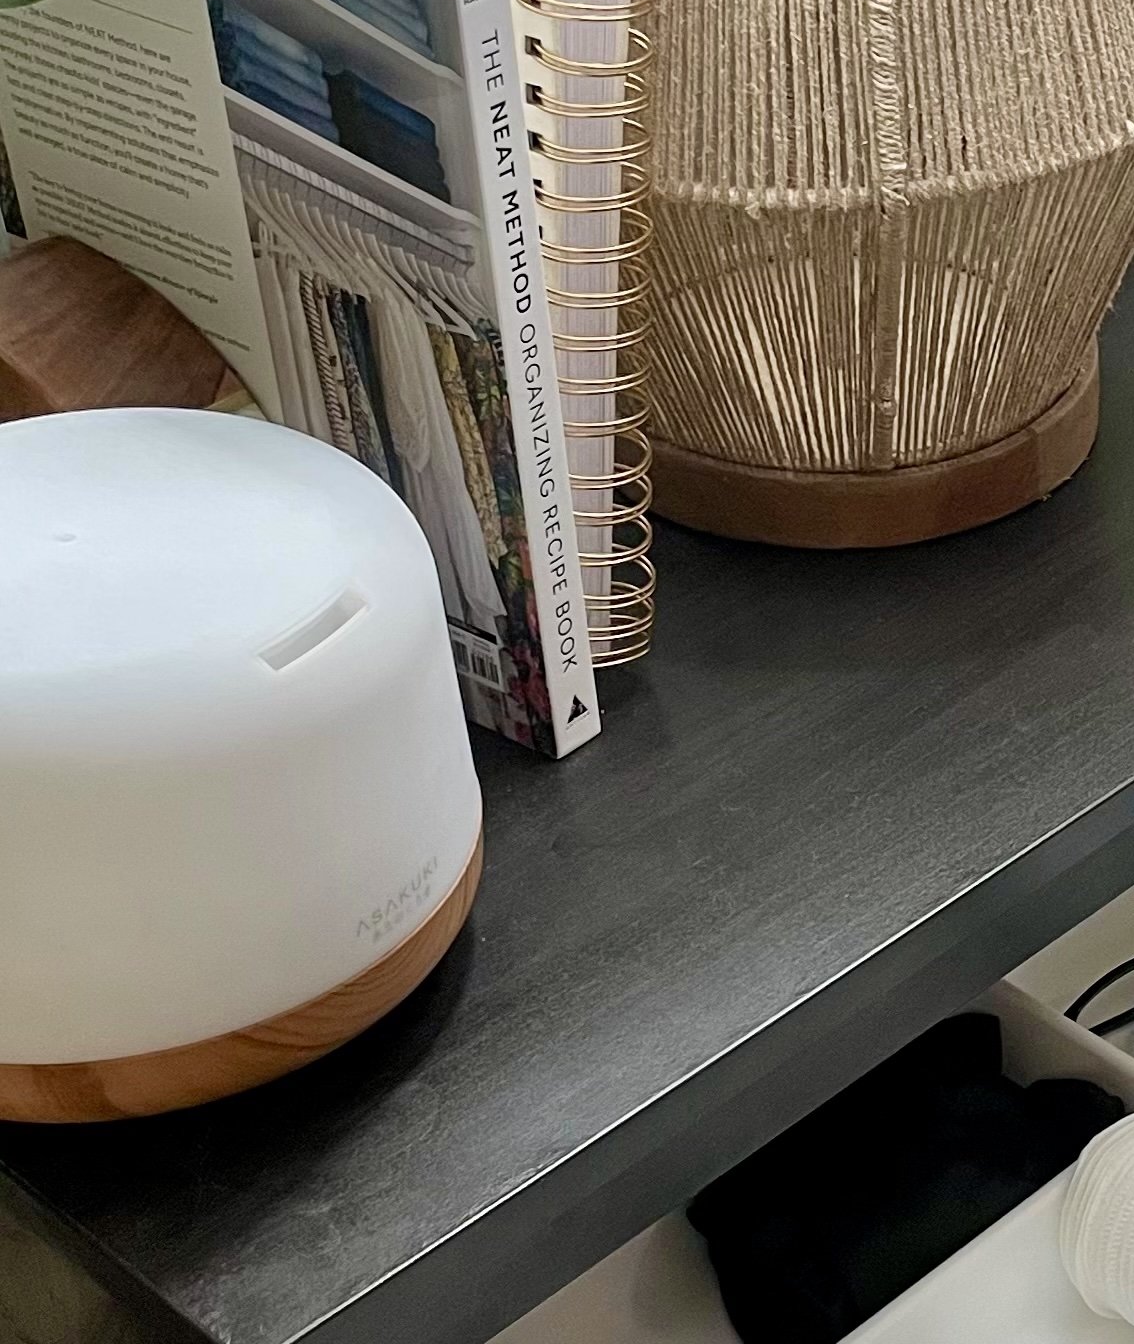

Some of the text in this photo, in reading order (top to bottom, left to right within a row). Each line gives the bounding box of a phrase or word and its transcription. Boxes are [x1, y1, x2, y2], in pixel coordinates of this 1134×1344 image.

[481, 29, 578, 673] THE NEAT METHOD ORGANIZING RECIPE BOOK
